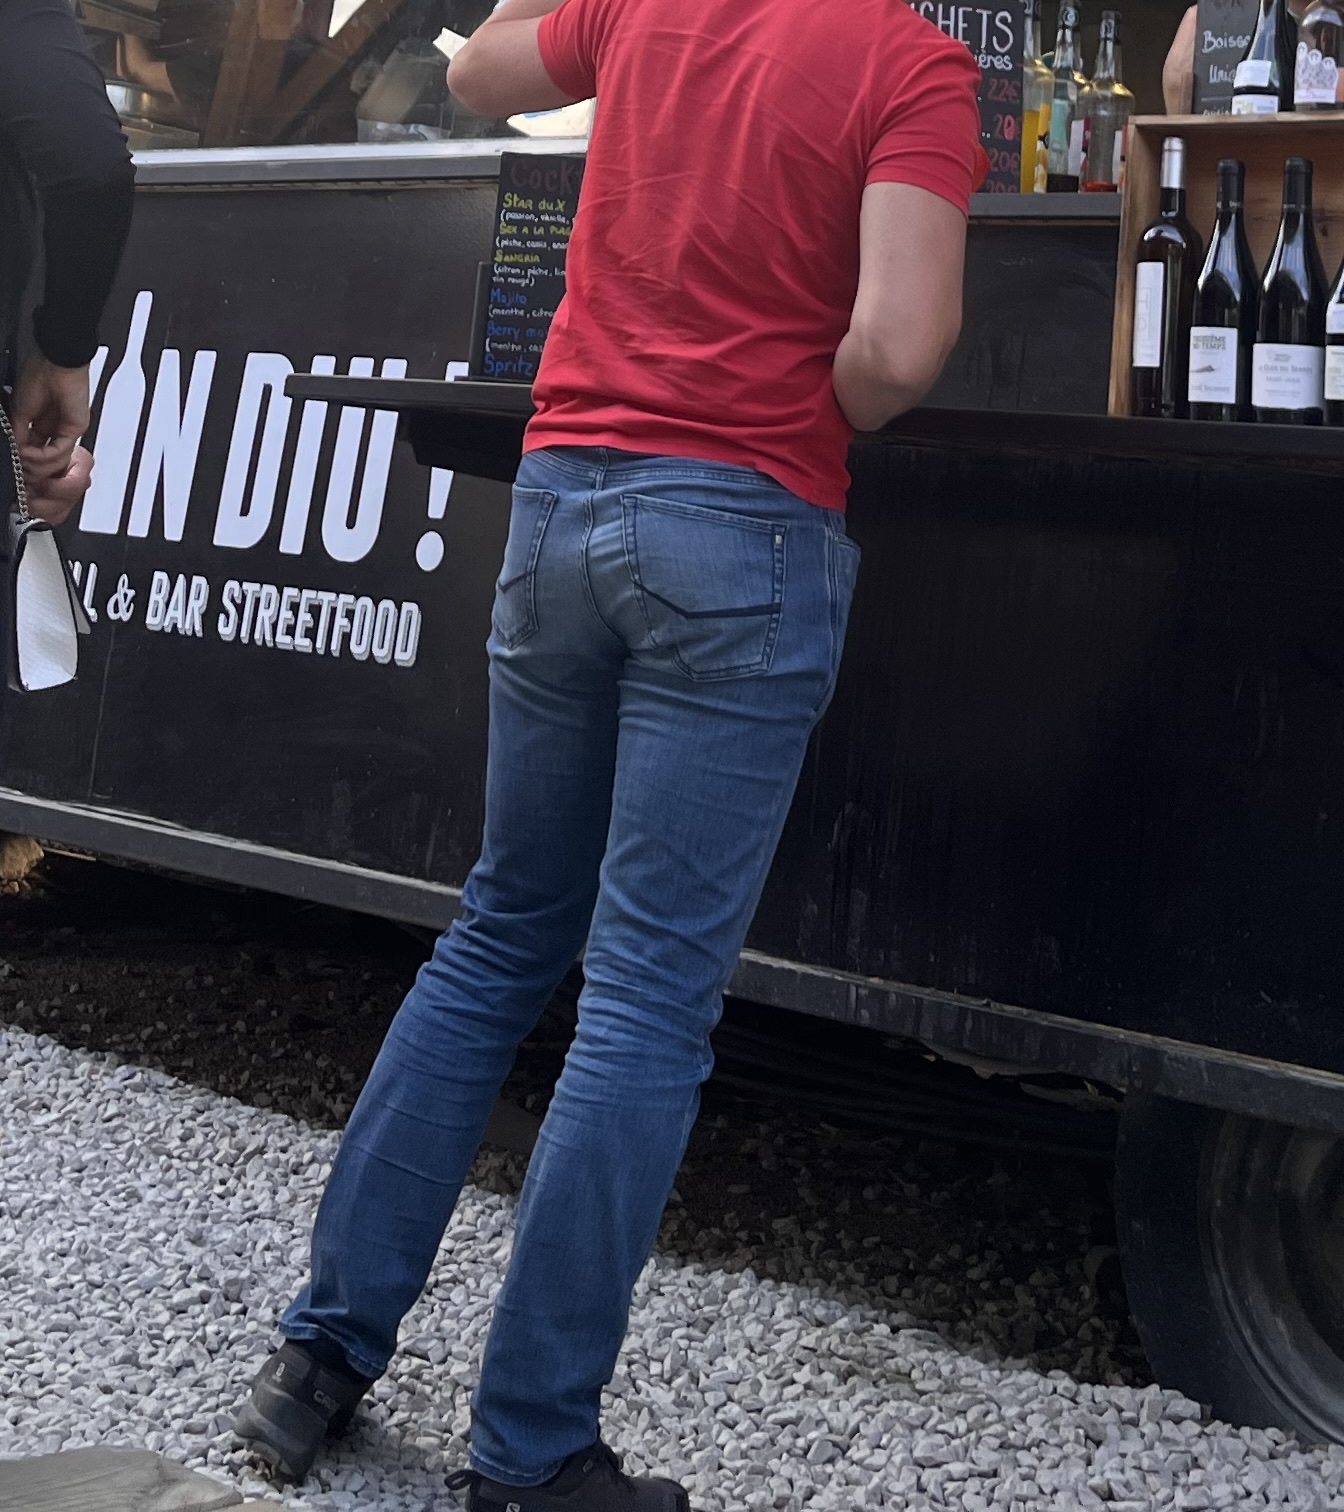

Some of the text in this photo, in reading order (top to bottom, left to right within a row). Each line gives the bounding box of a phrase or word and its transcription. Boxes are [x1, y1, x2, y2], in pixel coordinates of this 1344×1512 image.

[490, 287, 528, 307] Mojito
[483, 352, 534, 377] Spritz
[213, 352, 408, 563] DIU
[415, 360, 470, 572] !
[106, 573, 136, 622] &
[145, 570, 210, 638] BAR
[217, 579, 423, 668] STREETFOOD
